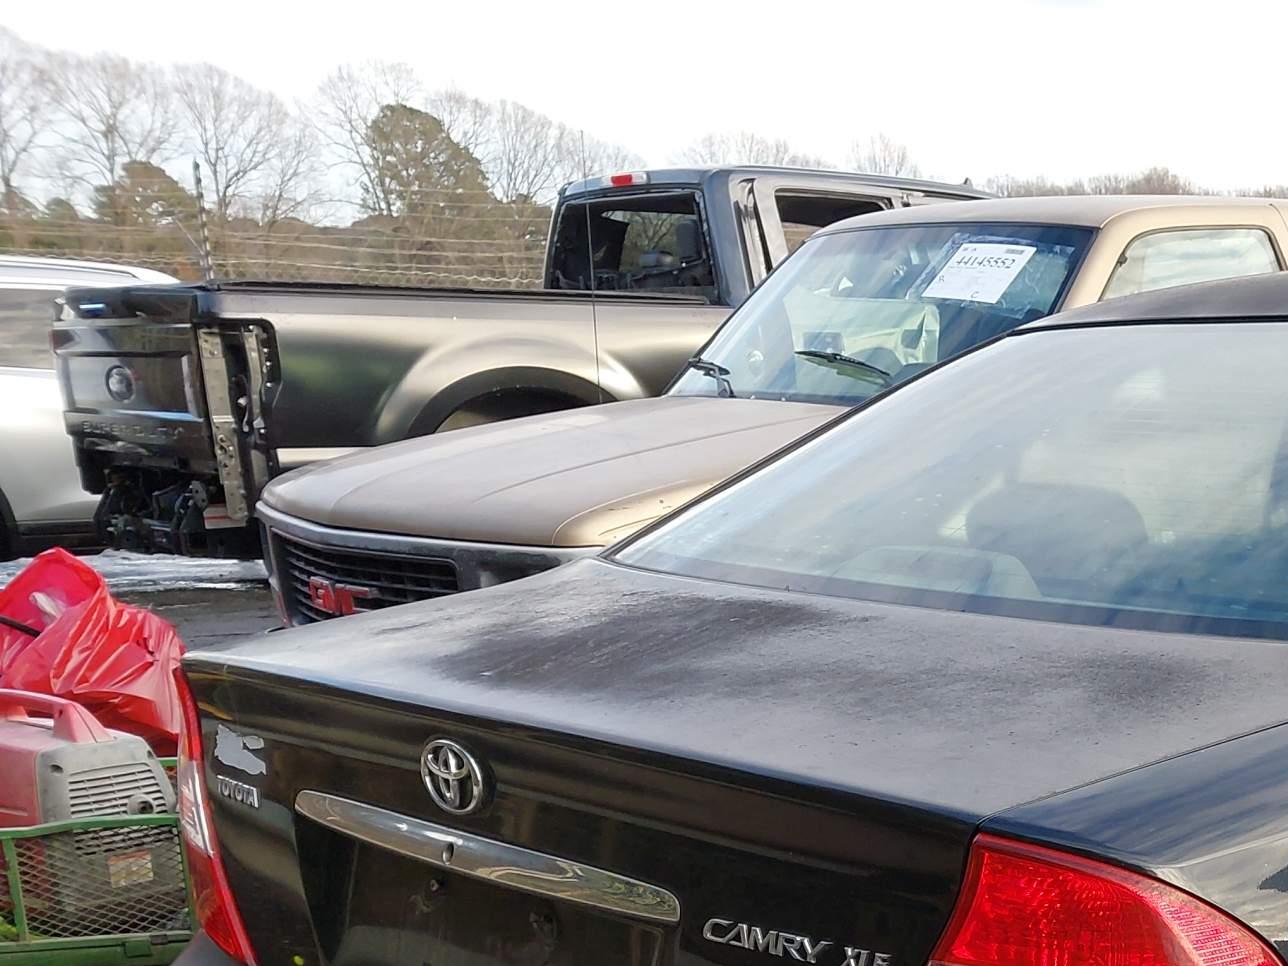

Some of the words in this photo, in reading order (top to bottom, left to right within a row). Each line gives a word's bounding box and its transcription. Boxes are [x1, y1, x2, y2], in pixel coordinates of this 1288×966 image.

[955, 255, 1016, 269] 44145552
[216, 774, 259, 809] TOYOTA
[702, 917, 834, 965] CAMRY
